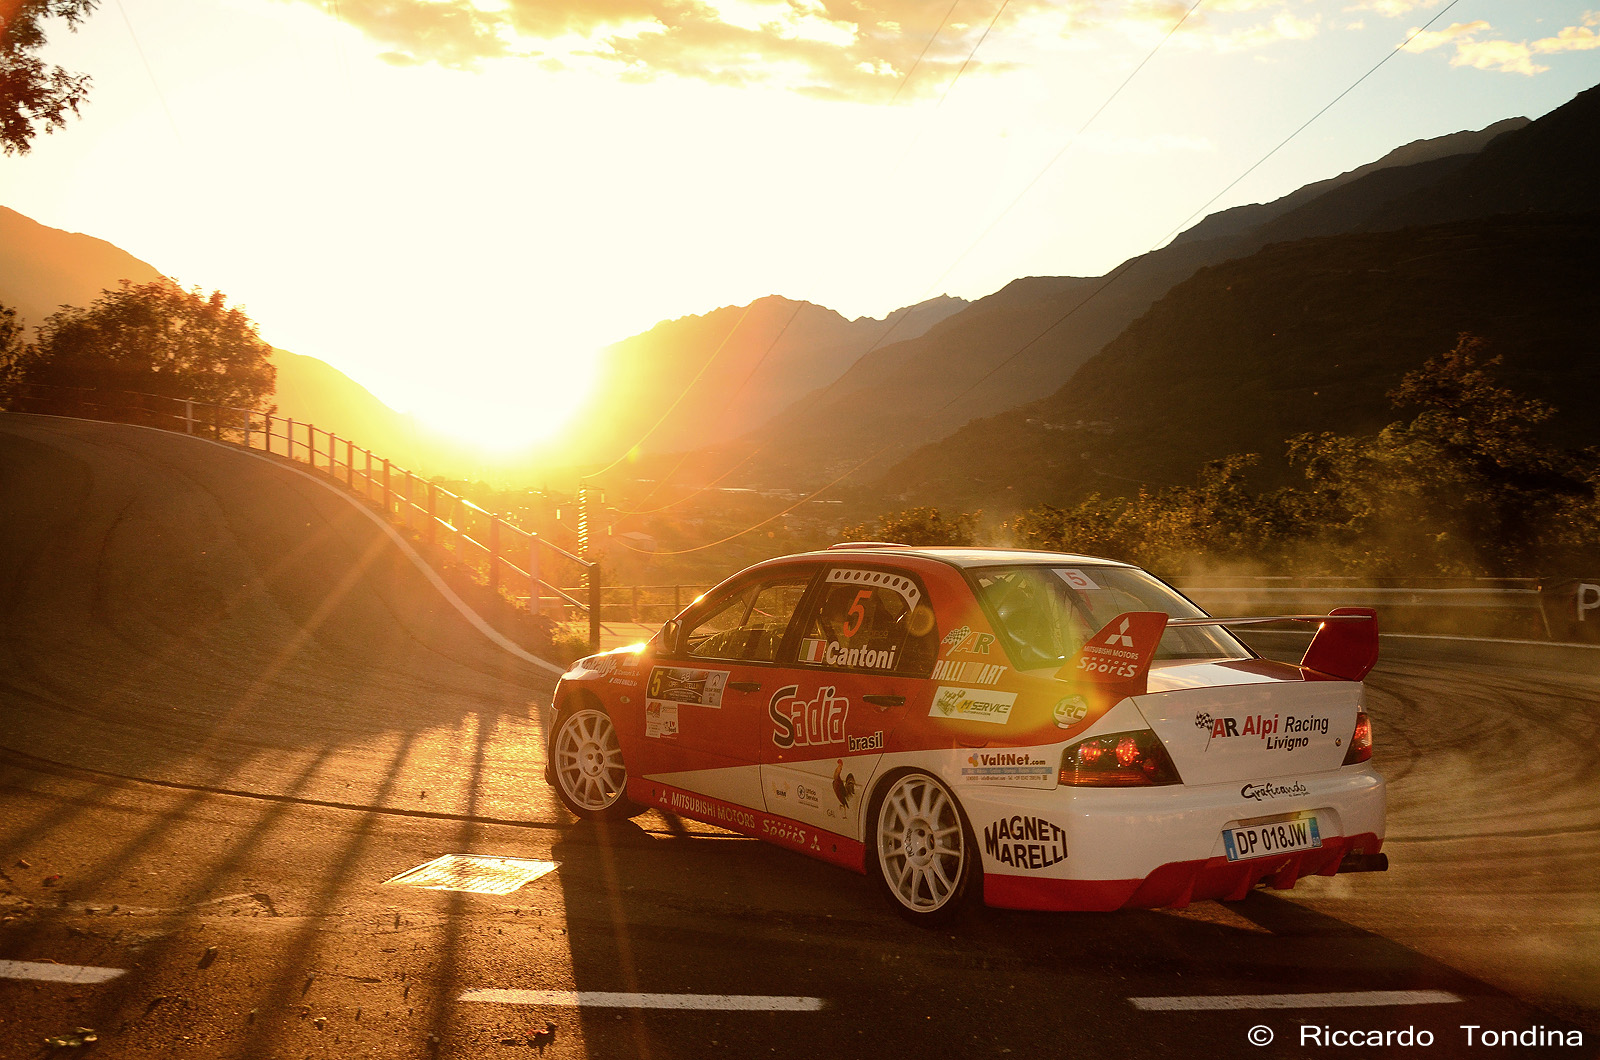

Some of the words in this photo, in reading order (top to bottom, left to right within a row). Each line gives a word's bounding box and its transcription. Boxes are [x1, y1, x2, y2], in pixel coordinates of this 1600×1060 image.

[1065, 571, 1087, 587] 5
[843, 589, 873, 638] 5
[826, 640, 896, 670] Cantoni
[955, 631, 996, 655] AR
[1084, 645, 1113, 656] MITSUBISHI
[1113, 649, 1139, 660] MOTORS
[651, 670, 664, 697] 5
[768, 684, 850, 749] Sadia
[1055, 704, 1087, 720] LRC
[1212, 717, 1239, 738] AR
[1242, 713, 1279, 740] Alpi
[1285, 715, 1329, 735] Racing
[848, 731, 883, 752] brasil
[1266, 736, 1309, 752] Livigno
[980, 753, 1046, 766] ValtNet.com
[1241, 781, 1307, 801] Graficando
[671, 791, 716, 818] MITSUBISHI
[717, 807, 756, 829] MOTORS
[1236, 830, 1258, 854] DP
[1261, 822, 1307, 851] 018JW
